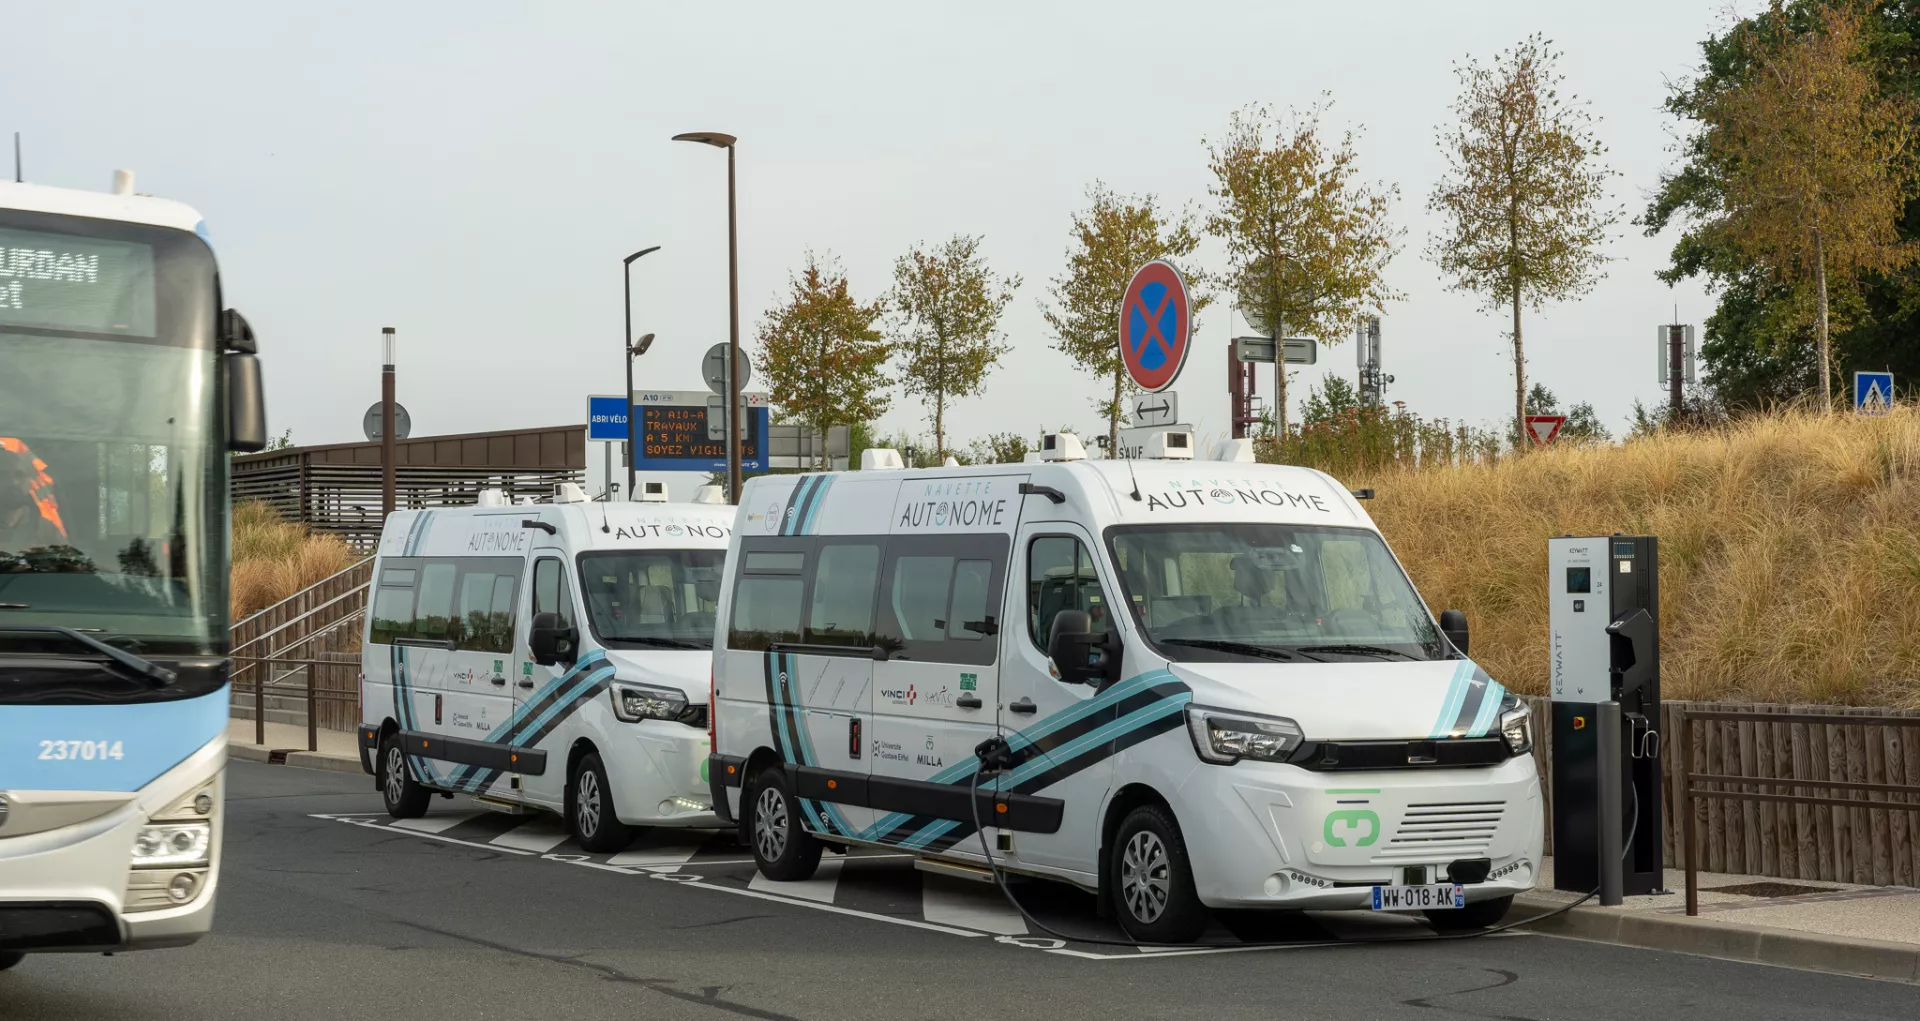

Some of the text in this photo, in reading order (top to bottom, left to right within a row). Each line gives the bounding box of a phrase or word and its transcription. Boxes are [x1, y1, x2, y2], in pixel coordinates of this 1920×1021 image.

[592, 413, 628, 424] ABRI VÉLO
[647, 422, 697, 430] TRAVAUX
[647, 434, 690, 442] A 5 KM
[647, 445, 755, 455] SOYEZ VIGILTS
[1119, 446, 1143, 460] SAUF
[924, 482, 991, 496] NAVETTE
[1169, 479, 1286, 490] NAVETTE
[1148, 489, 1331, 512] AUTONOME
[900, 500, 1006, 527] AUTONOME
[468, 531, 526, 552] AUTONOME
[1555, 633, 1563, 695] KEYWATT
[881, 690, 905, 699] VINCI
[38, 740, 124, 760] 237014
[917, 754, 943, 767] MILLA
[1383, 887, 1453, 908] WW-018-AK
